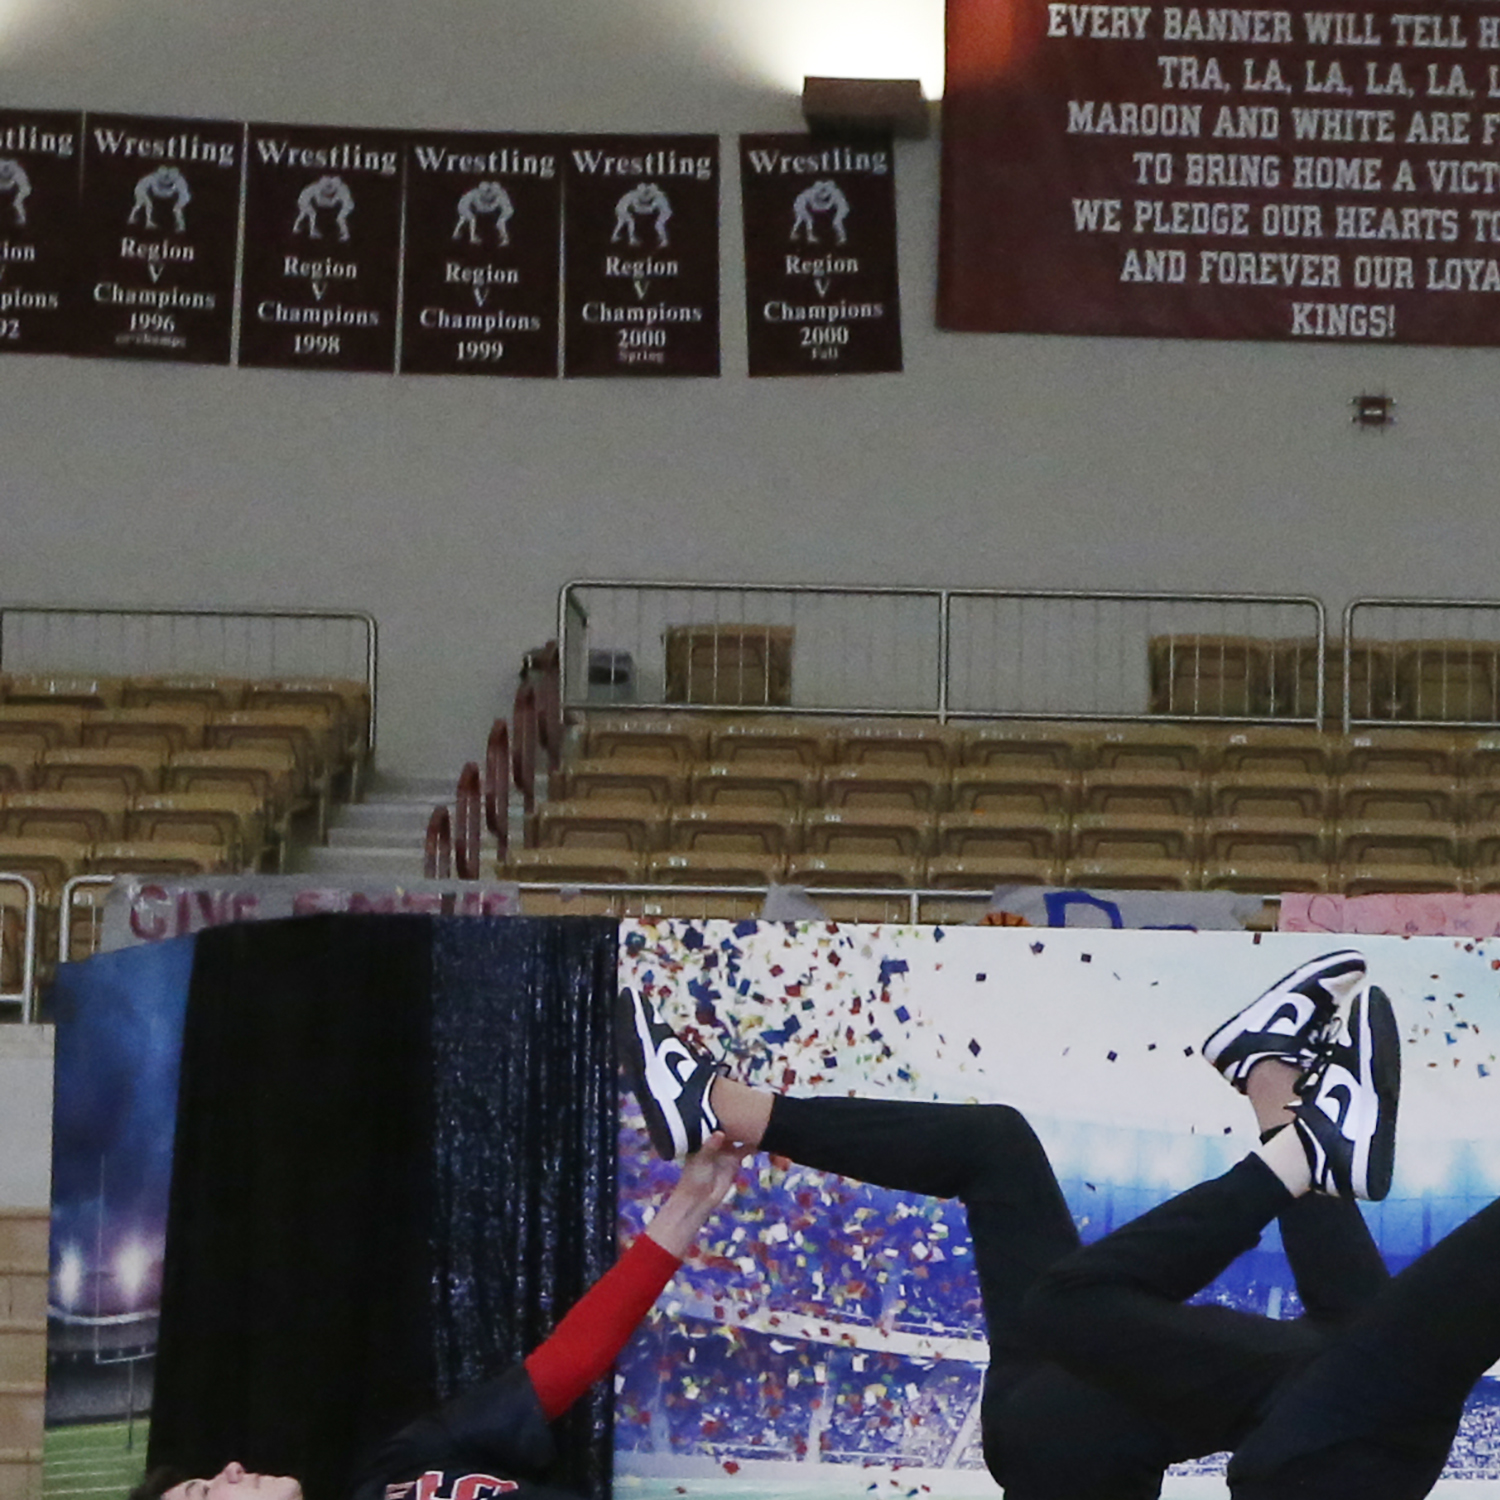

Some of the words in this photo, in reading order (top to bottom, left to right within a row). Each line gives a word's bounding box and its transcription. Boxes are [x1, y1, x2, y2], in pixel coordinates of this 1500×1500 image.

[1047, 2, 1150, 40] EVERY
[1163, 7, 1293, 43] BANNER
[1303, 11, 1381, 46] WILL
[1390, 13, 1468, 49] TELL
[1157, 54, 1231, 93] TRA,
[1242, 57, 1292, 94] LA,
[1304, 59, 1353, 96] LA,
[1365, 62, 1415, 98] LA,
[1426, 62, 1475, 98] LA,
[1067, 100, 1203, 137] MAROON
[1211, 105, 1279, 139] AND
[1291, 107, 1395, 144] WHITE
[1405, 111, 1470, 145] ARE
[93, 128, 234, 166] Wrestling
[257, 139, 396, 175] Wrestling
[415, 146, 555, 178] Wrestling
[571, 150, 711, 179] Wrestling
[748, 148, 887, 174] Wrestling
[1132, 152, 1173, 185] TO
[1185, 152, 1280, 188] BRING
[1292, 155, 1382, 191] HOME
[1391, 159, 1416, 192] A
[1072, 197, 1121, 233] WE
[1133, 199, 1250, 236] PLEDGE
[1262, 204, 1323, 238] OUR
[1335, 206, 1459, 242] HEARTS
[120, 237, 195, 261] Region
[148, 263, 163, 283] V
[284, 256, 358, 279] Region
[445, 262, 519, 286] Region
[605, 256, 678, 278] Region
[785, 254, 859, 276] Region
[1120, 249, 1186, 283] AND
[1198, 250, 1342, 288] FOREVER
[1354, 255, 1415, 289] OUR
[93, 283, 215, 309] Champions
[312, 281, 328, 300] V
[473, 287, 489, 306] V
[634, 280, 650, 299] V
[814, 278, 830, 297] V
[130, 313, 175, 332] 1996
[257, 302, 379, 327] Champions
[419, 308, 540, 334] Champions
[581, 302, 702, 326] Champions
[762, 300, 883, 323] Champions
[1291, 302, 1395, 338] KINGS!
[294, 335, 340, 354] 1998
[619, 328, 666, 349] 2000
[801, 326, 849, 346] 2000
[458, 341, 504, 360] 1999
[811, 347, 839, 359] Fall
